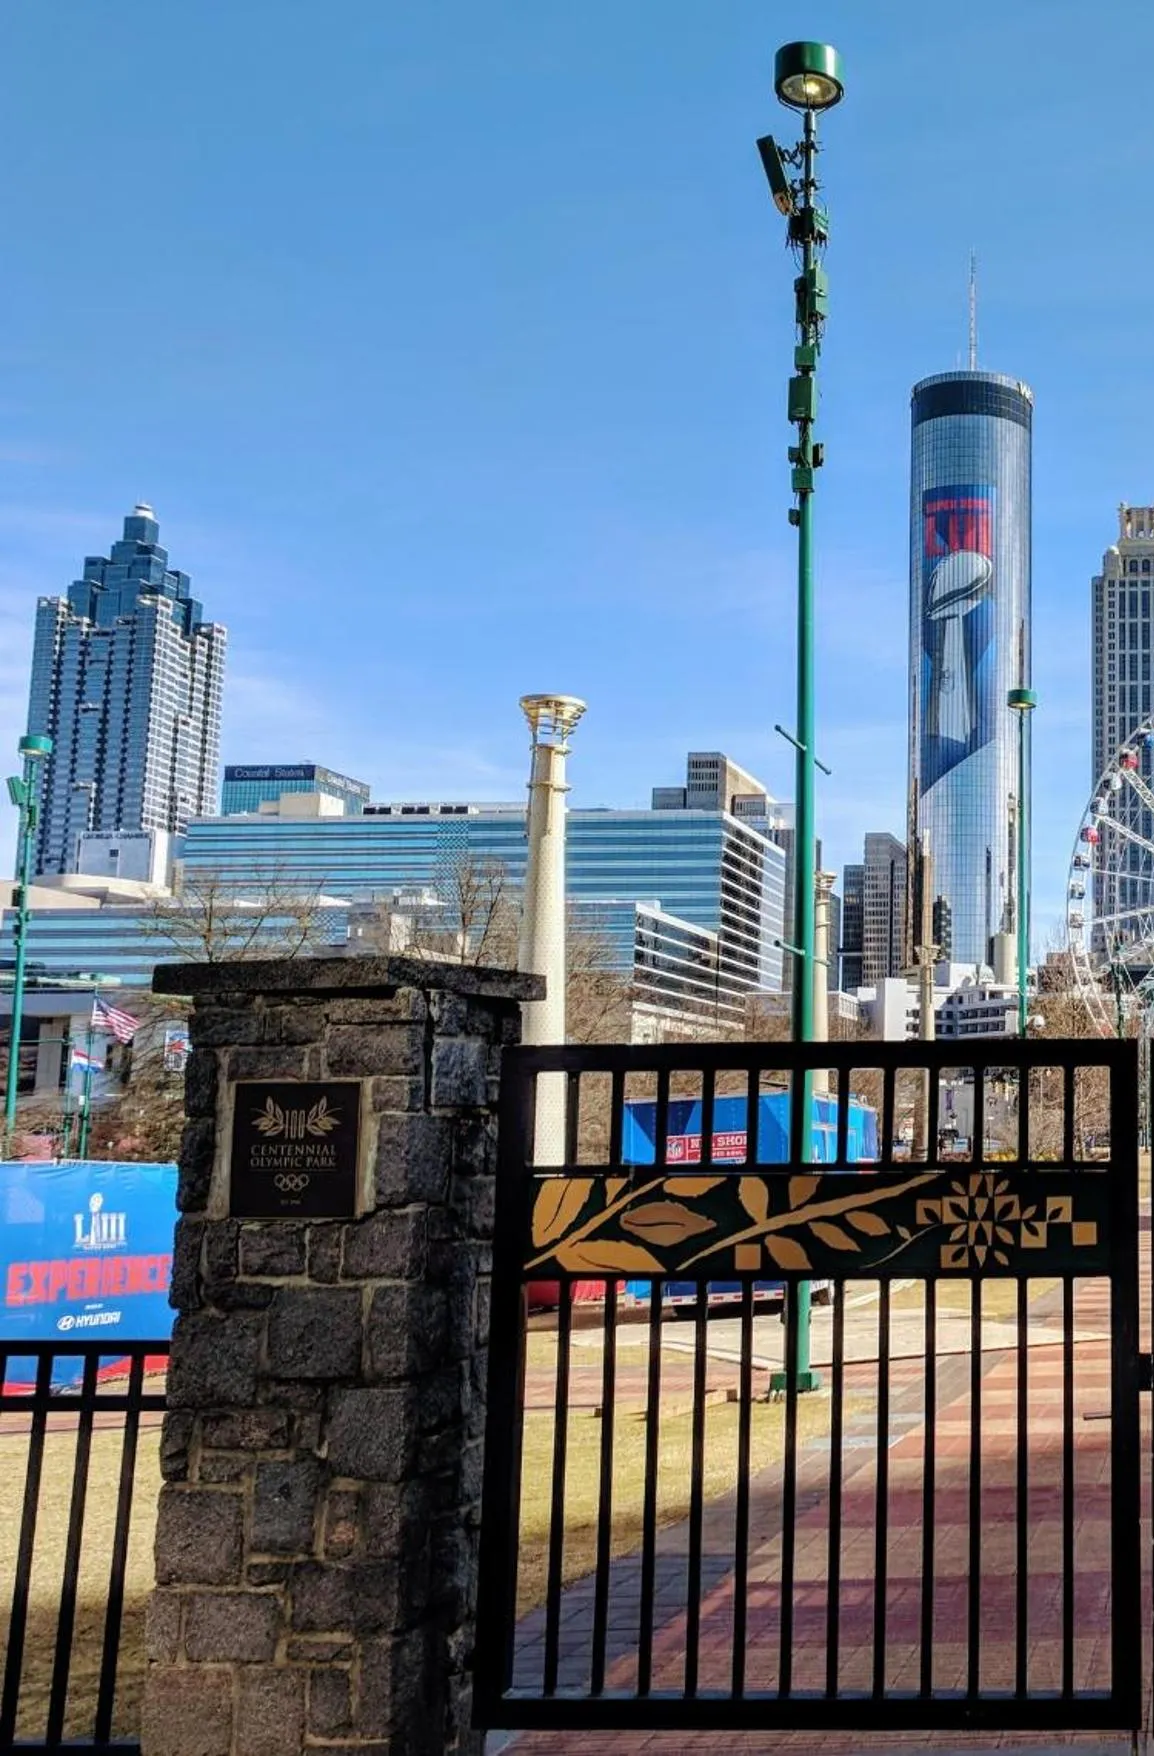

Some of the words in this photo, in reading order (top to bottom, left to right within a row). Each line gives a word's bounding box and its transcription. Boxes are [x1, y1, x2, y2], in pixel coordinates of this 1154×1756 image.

[284, 1109, 306, 1140] 100
[251, 1144, 336, 1156] CENTENNIAL
[250, 1156, 302, 1168] OLYMPIC
[306, 1156, 337, 1167] PARK
[6, 1253, 173, 1308] EXPERIENCE
[75, 1311, 122, 1329] HYUNDAI
